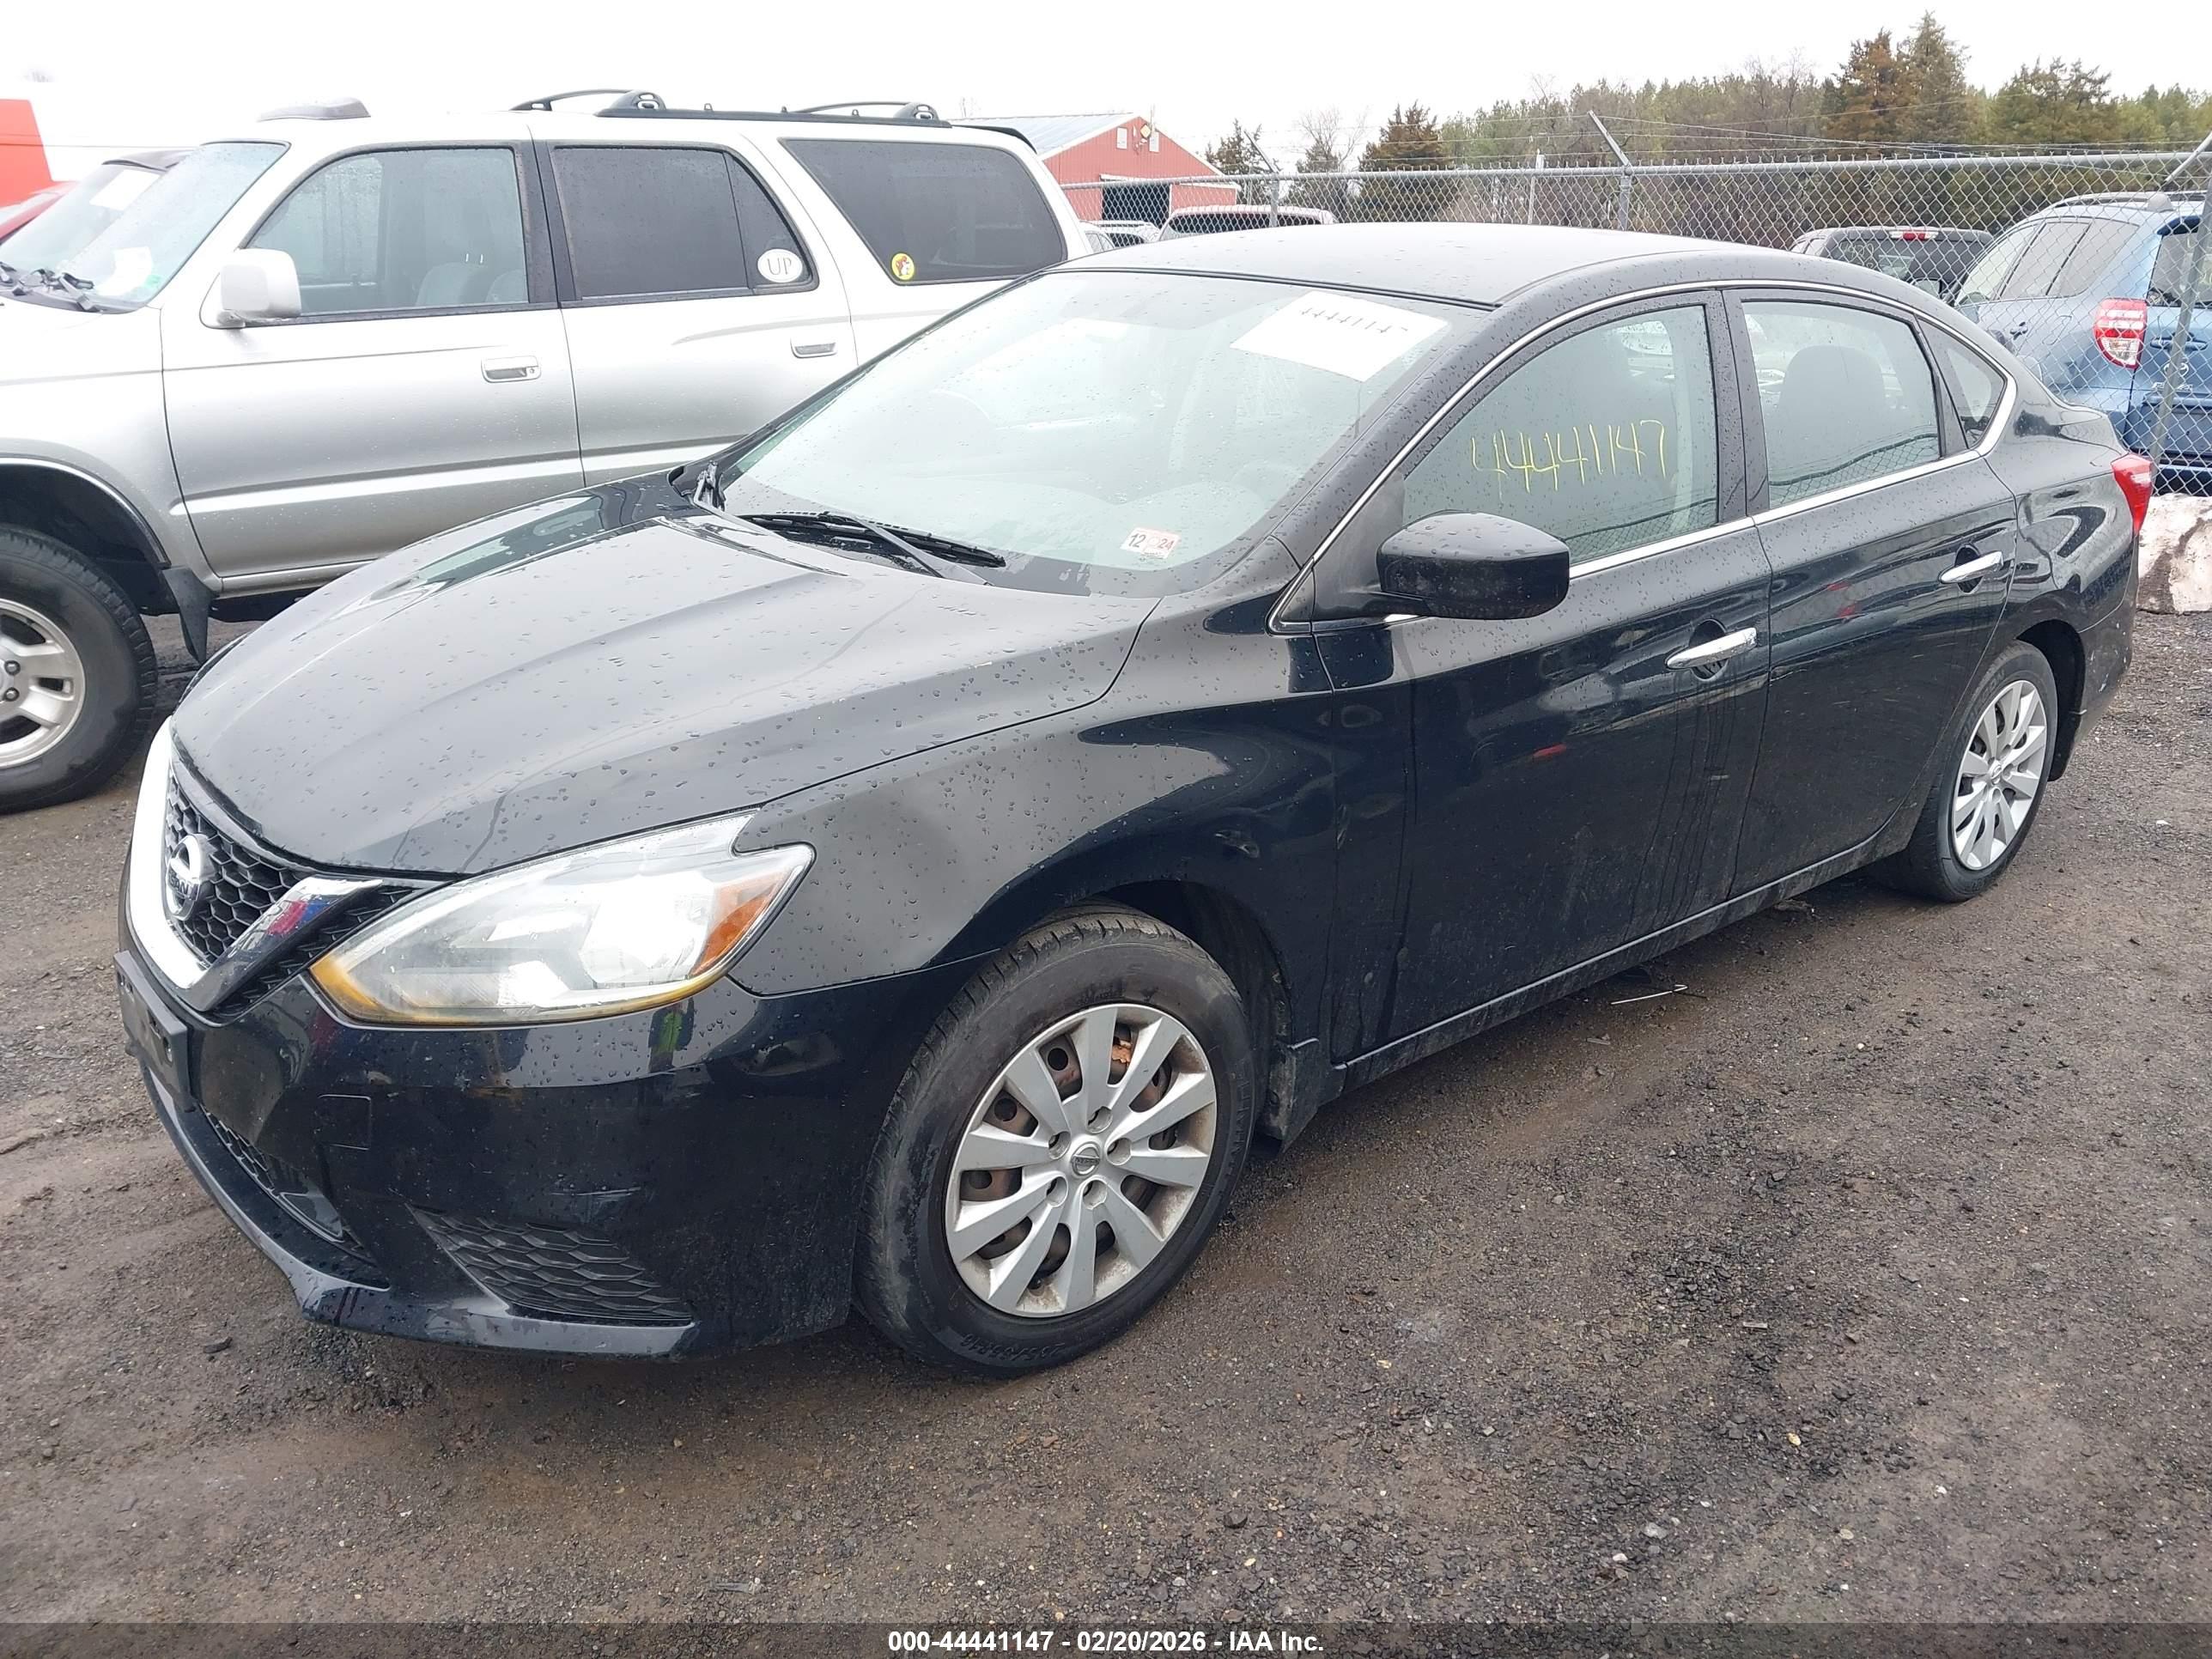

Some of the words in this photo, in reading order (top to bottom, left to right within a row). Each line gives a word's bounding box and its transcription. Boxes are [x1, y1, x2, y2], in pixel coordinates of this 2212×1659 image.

[766, 257, 792, 276] UP
[1471, 419, 1666, 501] 44441147
[1127, 532, 1146, 548] 12
[1157, 538, 1175, 550] 24
